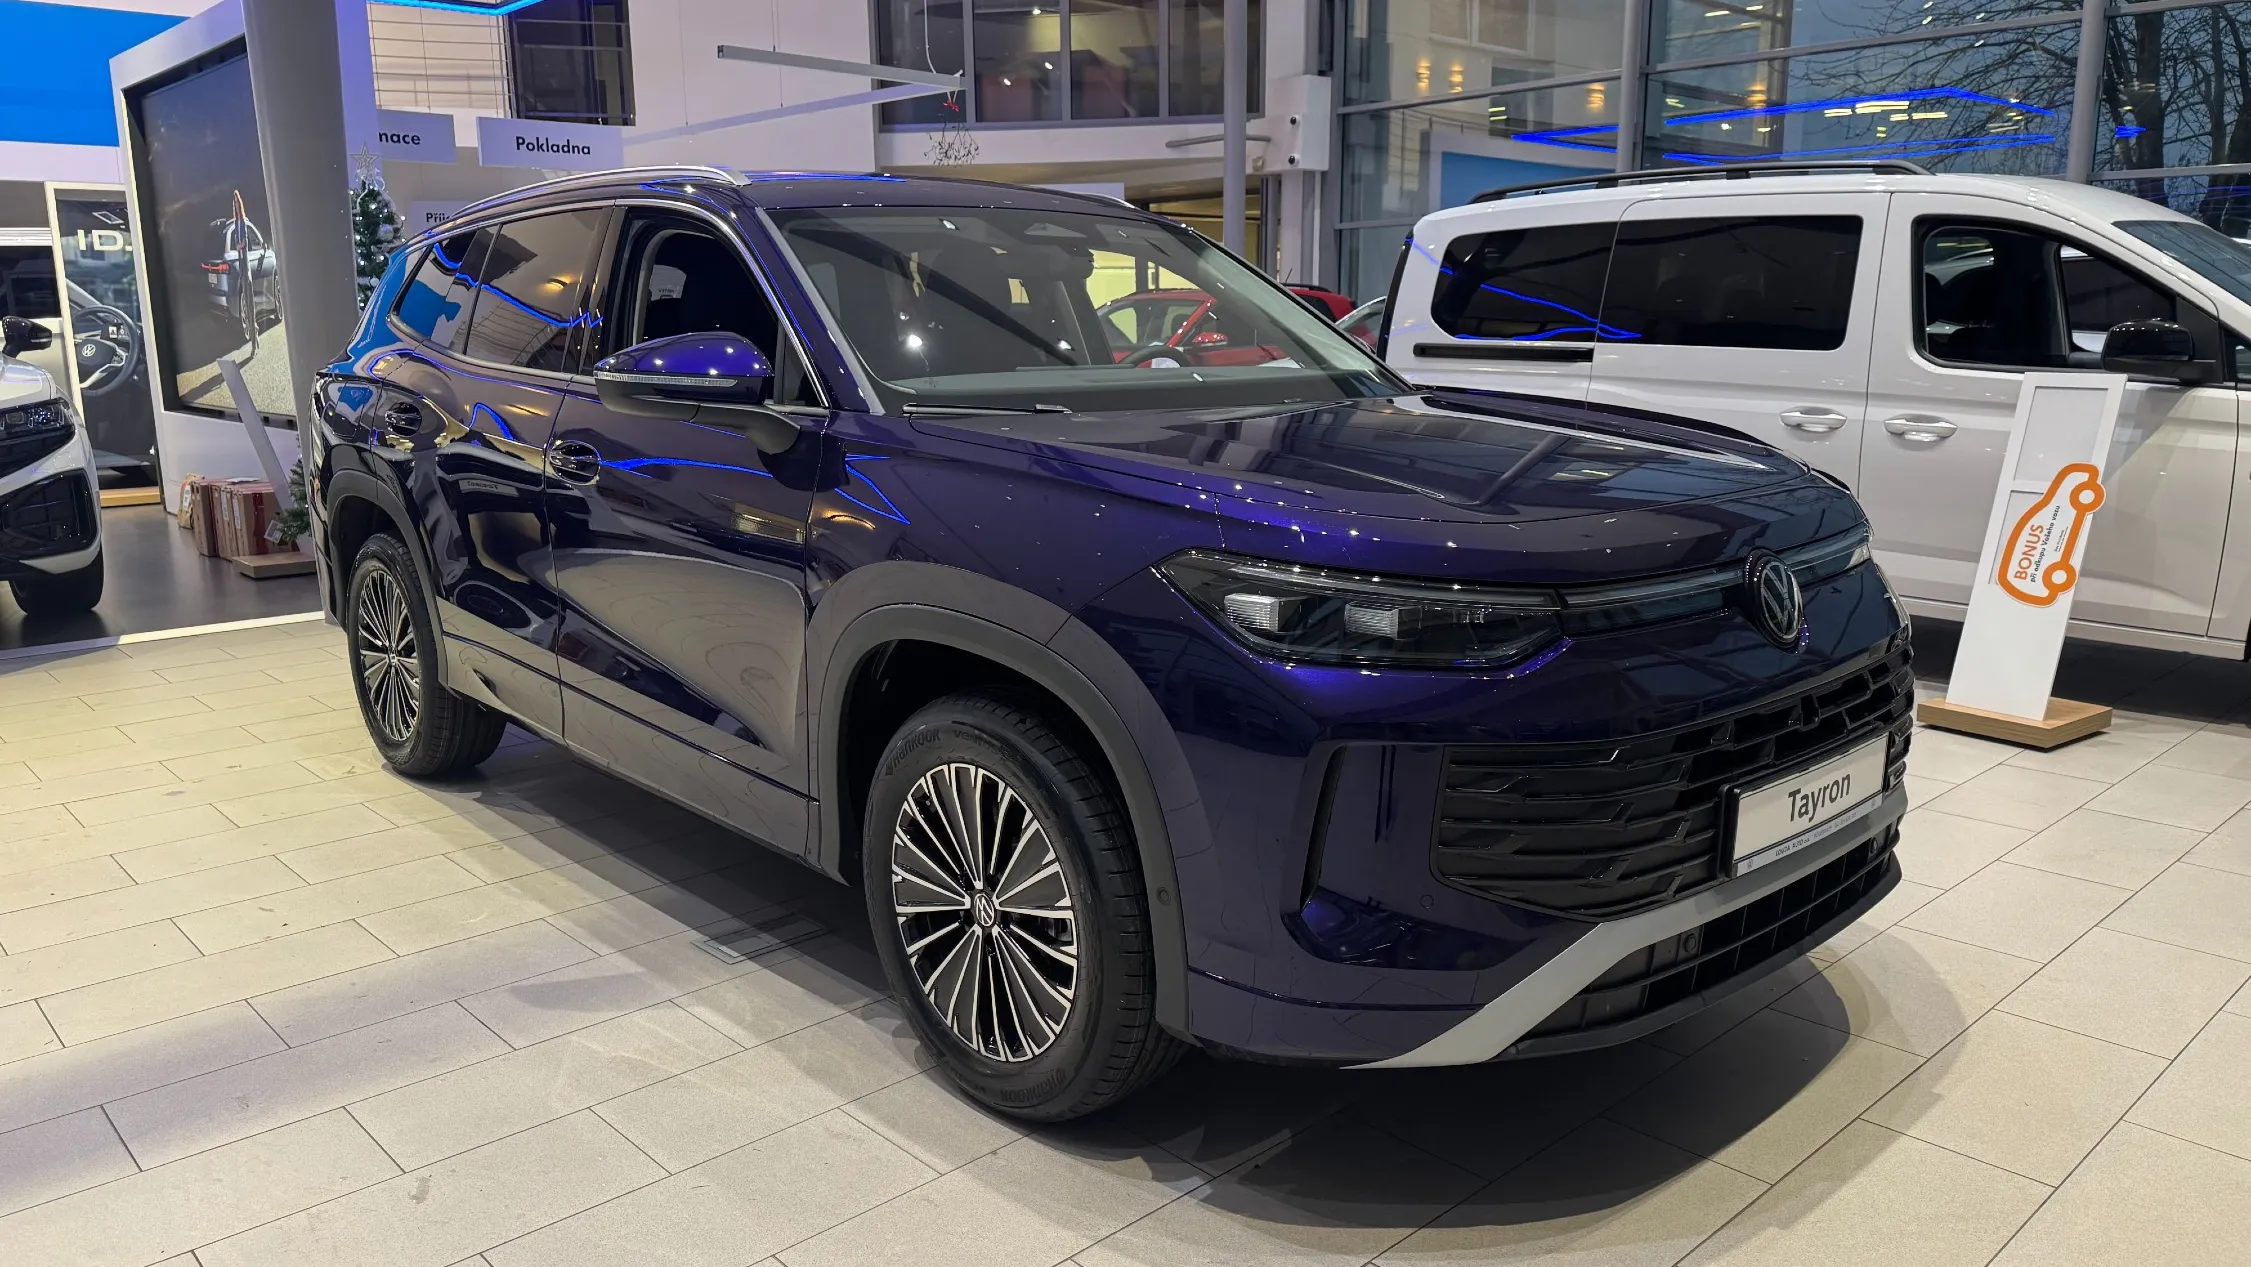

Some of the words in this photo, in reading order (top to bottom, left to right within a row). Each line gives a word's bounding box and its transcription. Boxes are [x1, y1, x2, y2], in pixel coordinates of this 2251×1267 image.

[515, 136, 591, 155] Pokladna
[426, 212, 450, 223] Příj
[77, 229, 133, 252] ID.
[2052, 505, 2060, 521] vozu
[2014, 524, 2044, 580] BONUS
[1788, 773, 1851, 823] Tayron
